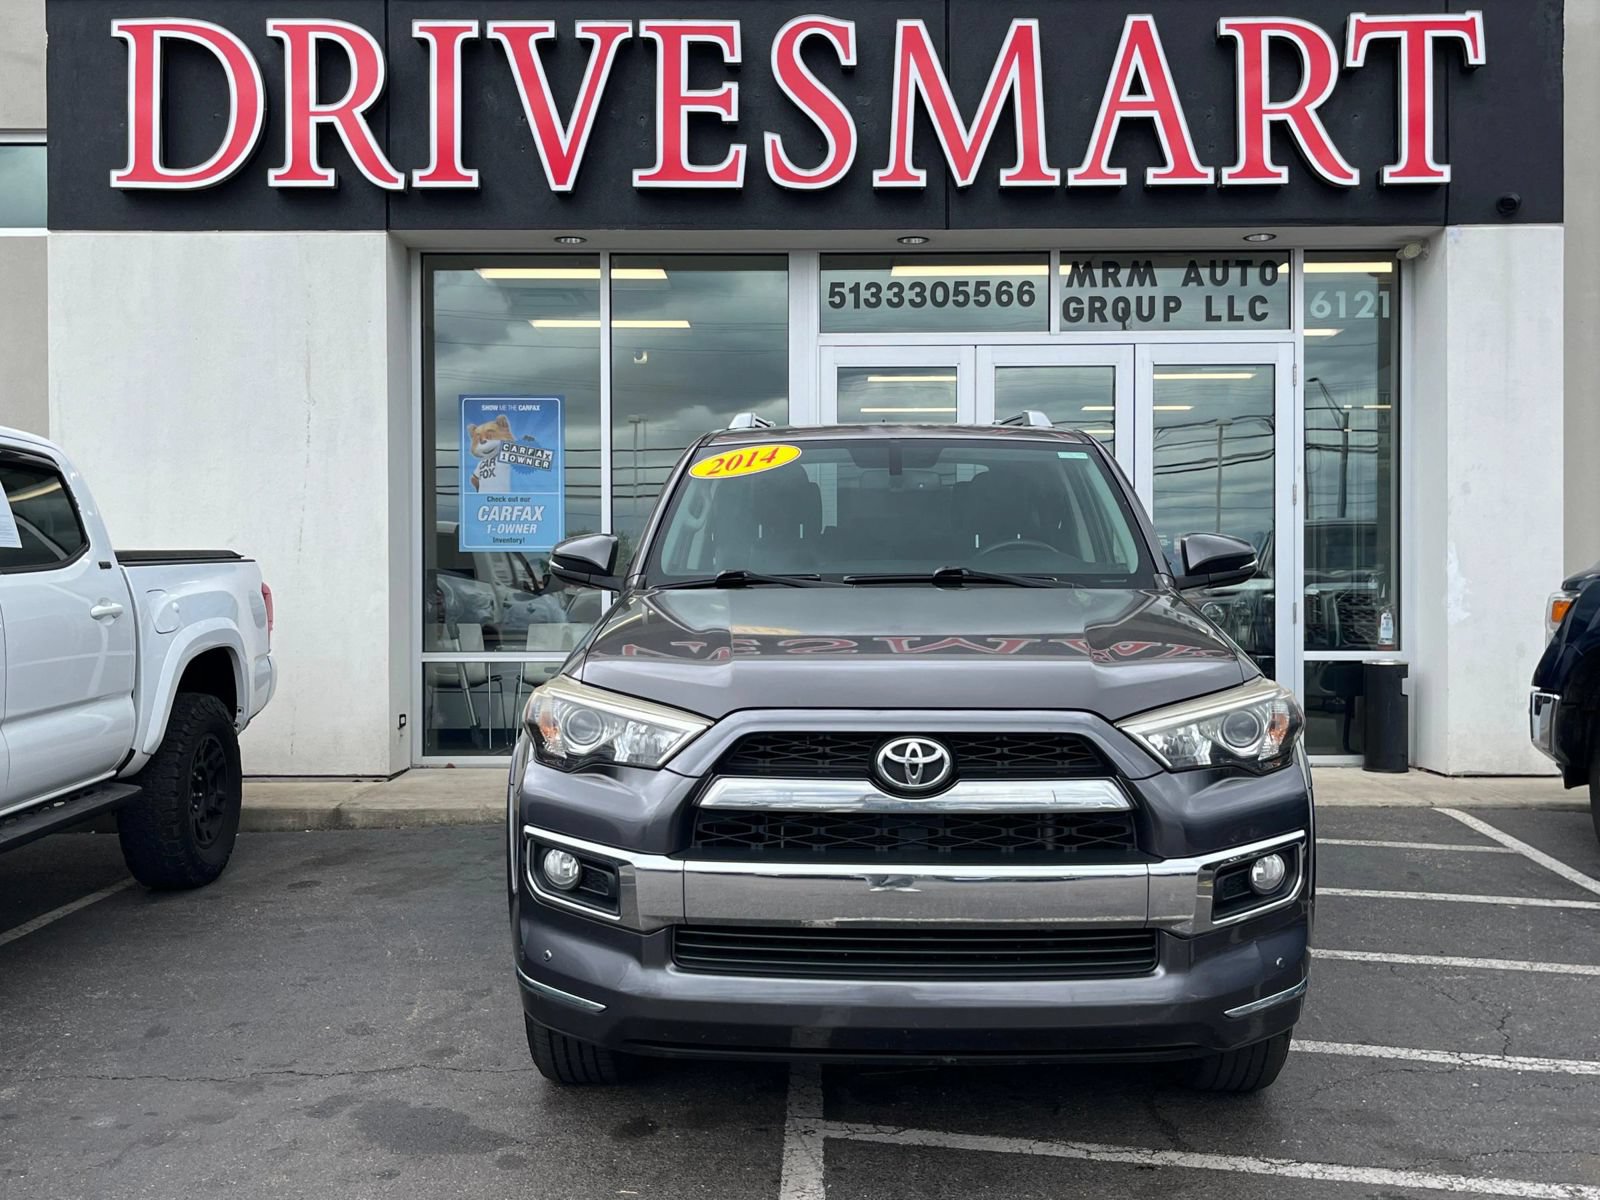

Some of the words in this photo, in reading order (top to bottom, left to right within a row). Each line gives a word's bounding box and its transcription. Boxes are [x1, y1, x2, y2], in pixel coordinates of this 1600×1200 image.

[110, 10, 1487, 192] DRIVESMART
[1065, 260, 1158, 288] MRM
[1181, 259, 1279, 287] AUTO
[828, 280, 1036, 310] 5133305566
[1310, 290, 1390, 319] 6121
[1062, 295, 1183, 323] GROUP
[1205, 295, 1269, 322] LLC
[503, 443, 552, 460] CARFAX
[706, 447, 780, 475] 2014
[479, 458, 496, 470] CAR
[479, 468, 497, 479] FOX
[478, 505, 545, 521] CARFAX
[487, 523, 538, 534] 1-OWNER
[492, 537, 526, 545] Inventory!
